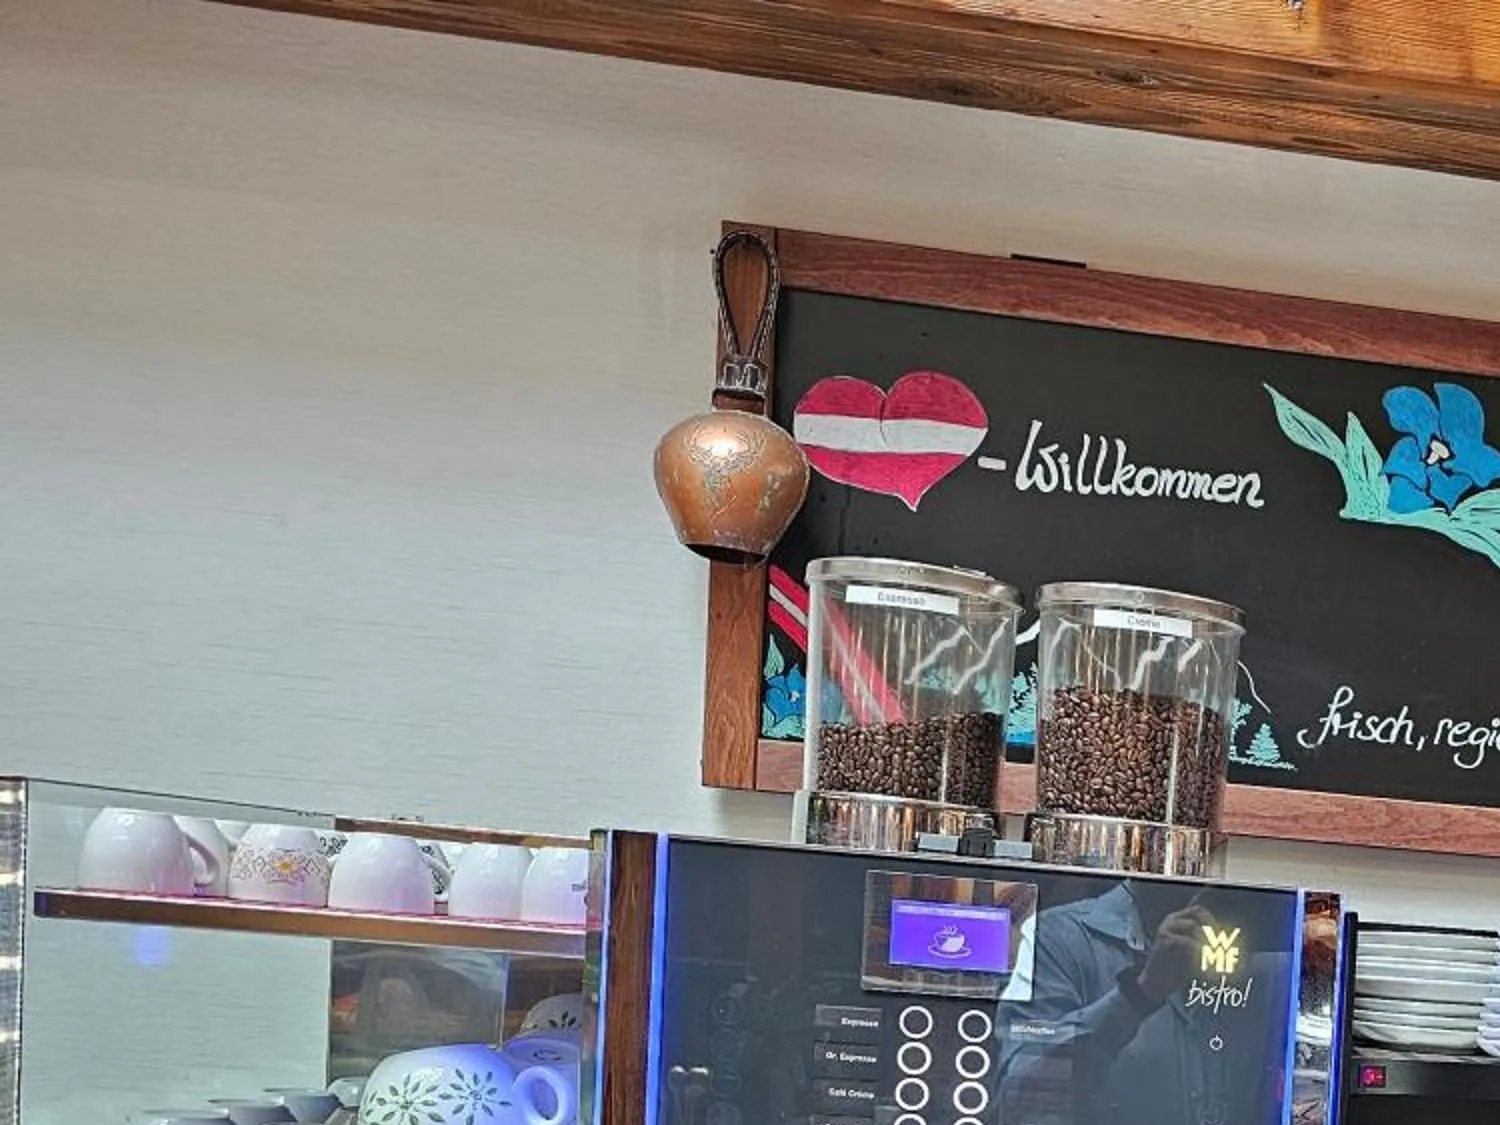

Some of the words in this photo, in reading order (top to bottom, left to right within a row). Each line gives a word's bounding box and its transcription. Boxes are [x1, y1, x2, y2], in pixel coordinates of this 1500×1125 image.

[1297, 685, 1426, 752] frisch,
[1202, 925, 1241, 973] WMF
[1184, 975, 1253, 1014] bistro!
